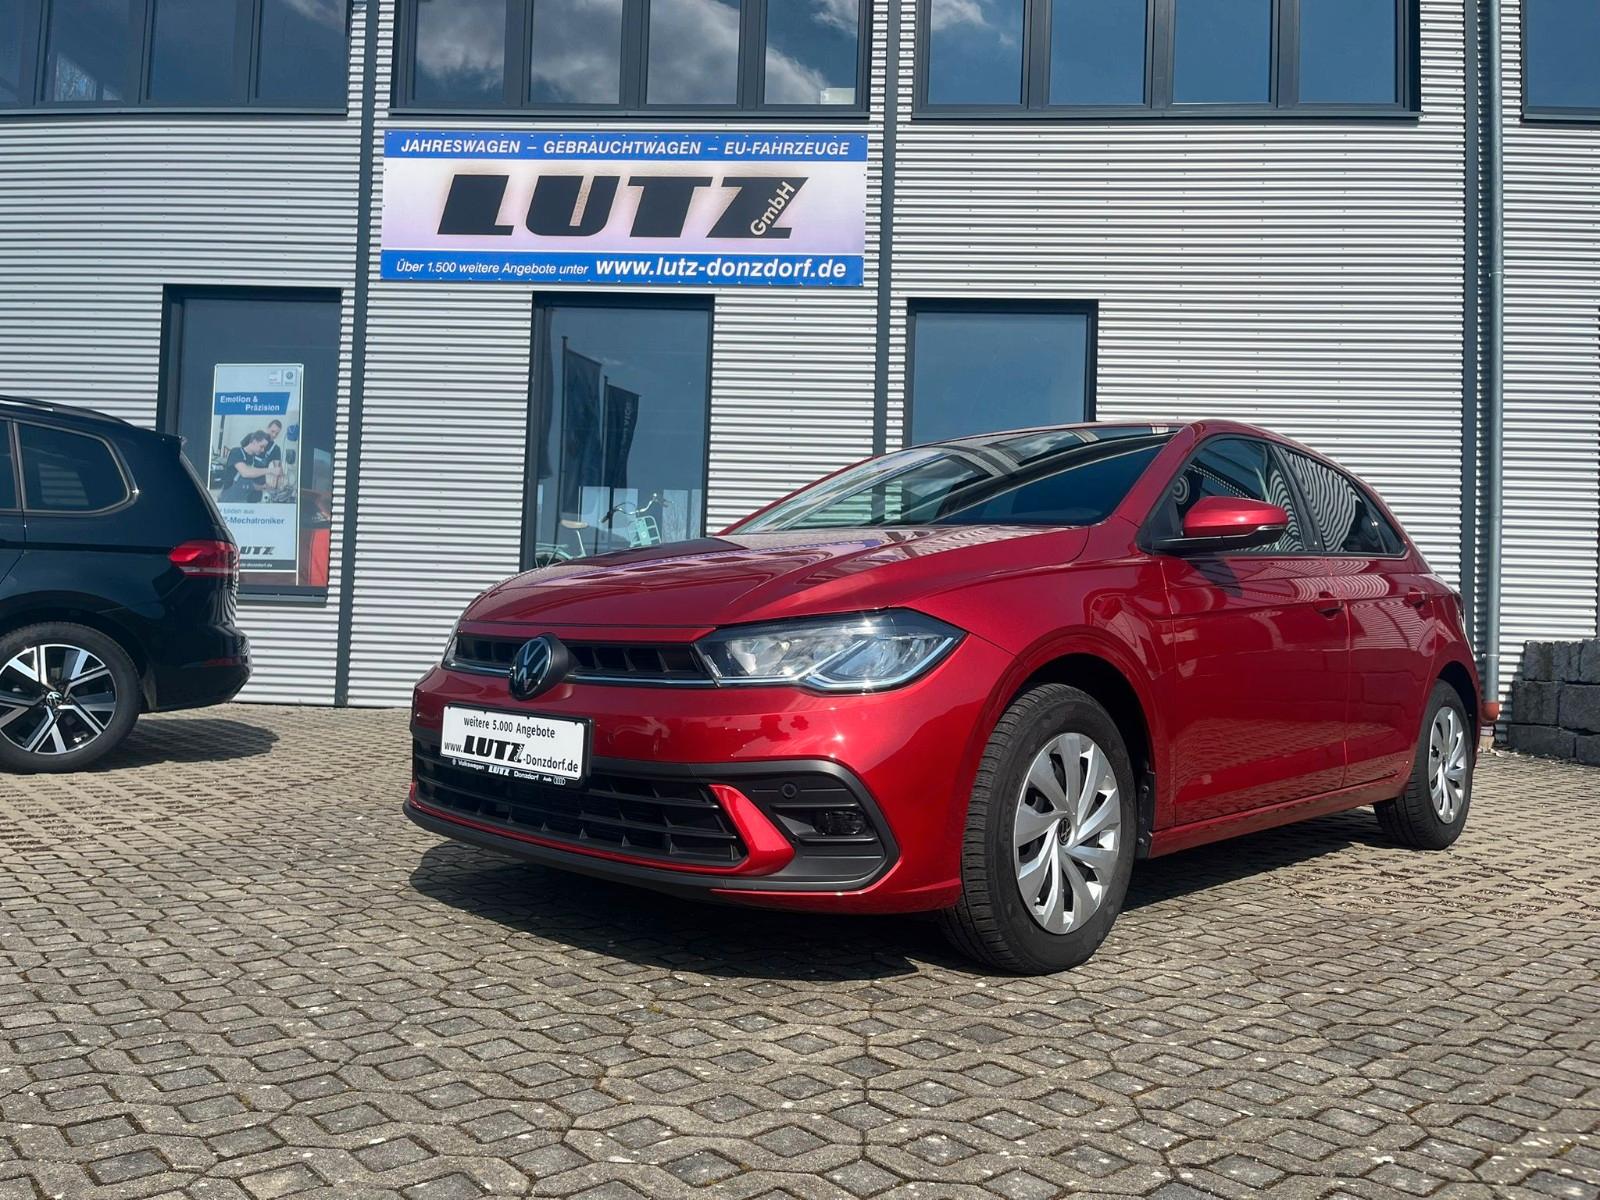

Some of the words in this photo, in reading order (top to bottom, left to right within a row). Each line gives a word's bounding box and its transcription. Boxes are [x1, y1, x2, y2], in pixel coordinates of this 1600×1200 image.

[401, 139, 520, 153] JAHRESWAGEN
[543, 141, 701, 155] GEBRAUCHTWAGEN
[724, 141, 850, 156] EU-FAHRZEUGE
[436, 174, 809, 239] LUTZ
[749, 181, 795, 237] GmbH
[396, 258, 425, 273] Über
[427, 261, 457, 273] 1.500
[459, 262, 500, 274] weitere
[501, 263, 556, 276] Angebote
[559, 264, 589, 275] unter
[596, 257, 846, 280] www.lutz-donzdorf.de
[220, 395, 251, 403] Emotion
[245, 404, 280, 412] Präzision
[224, 516, 285, 525] -Mechatroniker
[239, 546, 275, 555] UTZ
[463, 715, 490, 730] weitere
[492, 719, 513, 733] 5.000
[516, 722, 556, 738] Angebote
[488, 765, 510, 777] LUTZ
